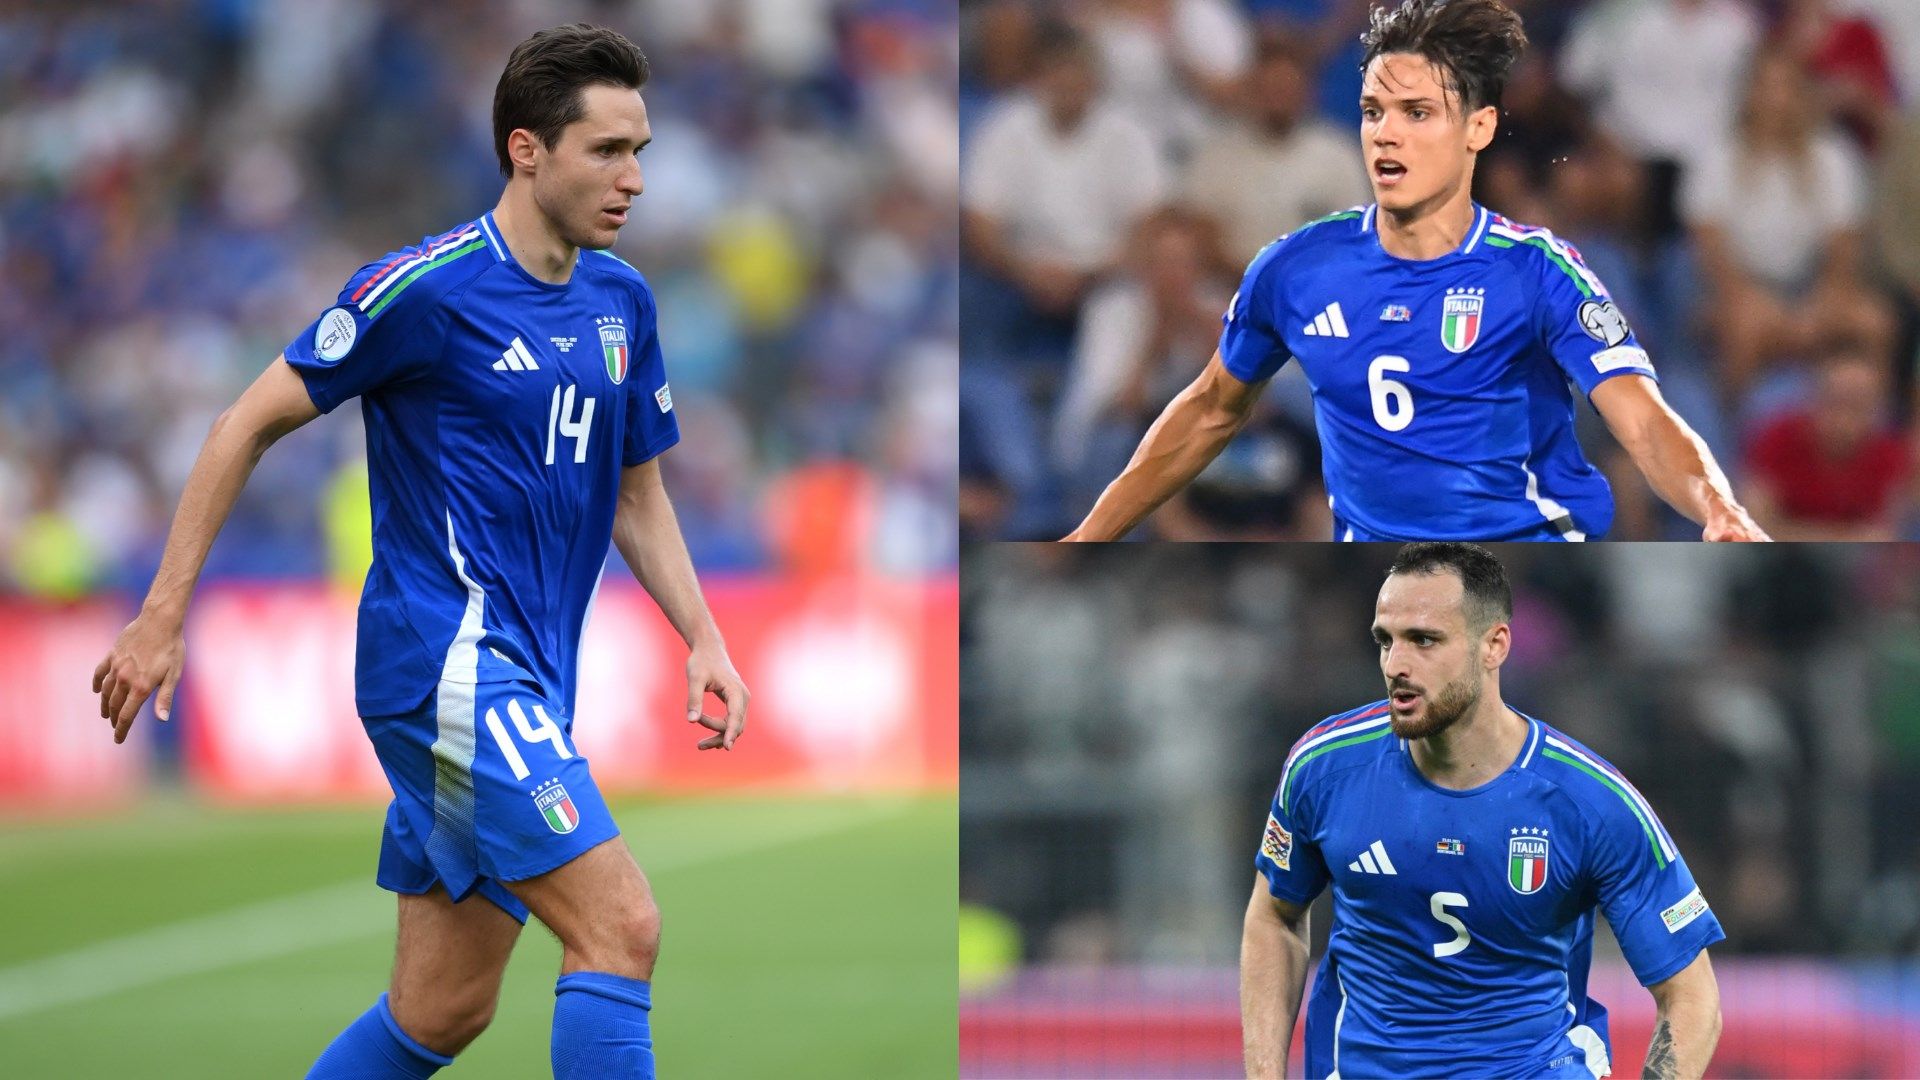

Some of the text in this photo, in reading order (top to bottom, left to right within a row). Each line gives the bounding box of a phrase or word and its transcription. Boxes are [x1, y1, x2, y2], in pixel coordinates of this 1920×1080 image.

[1446, 299, 1479, 312] ITALIA
[602, 330, 625, 342] ITALIA
[1367, 355, 1415, 432] 6
[545, 384, 596, 466] 14
[485, 698, 573, 782] 14
[537, 788, 565, 809] ITALIA
[1512, 841, 1545, 854] ITALIA
[1430, 891, 1471, 958] 5
